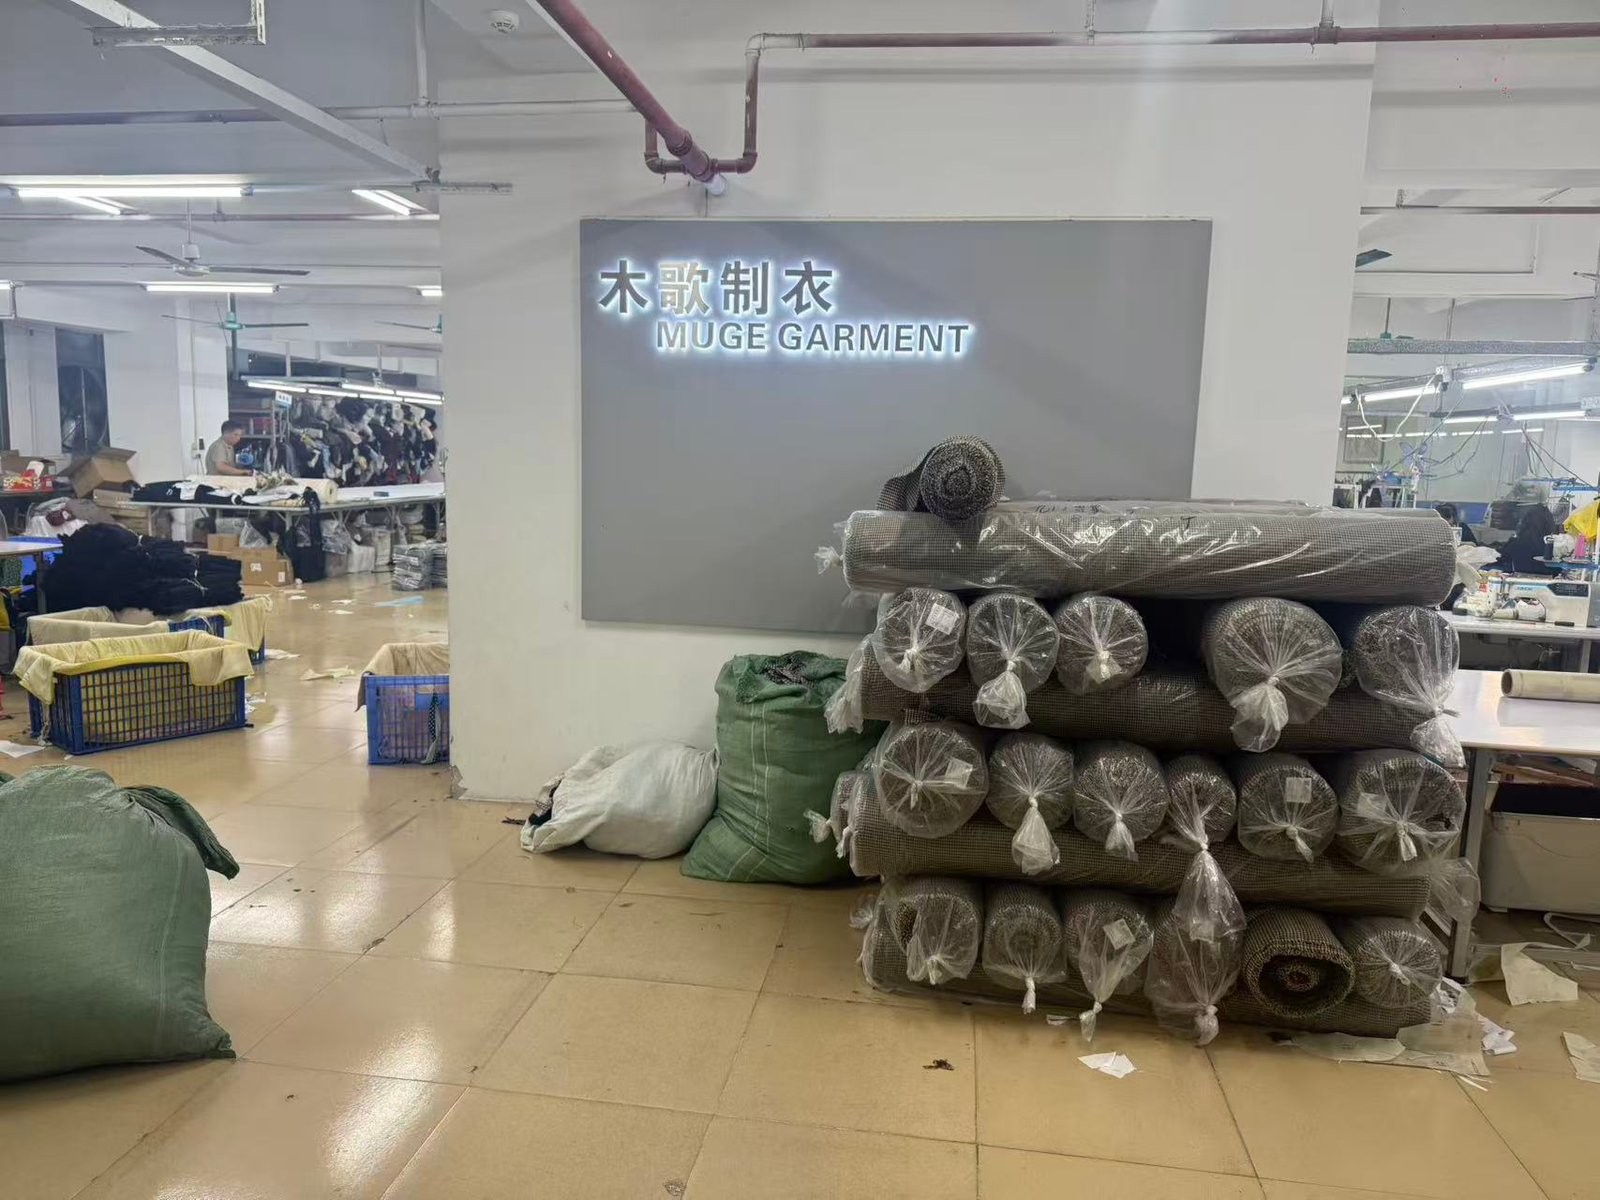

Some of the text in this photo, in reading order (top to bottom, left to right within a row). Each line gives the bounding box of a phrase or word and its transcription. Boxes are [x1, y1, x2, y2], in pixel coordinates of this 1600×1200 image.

[599, 260, 834, 315] 木歌制衣
[656, 322, 970, 354] MUGE GARMENT
